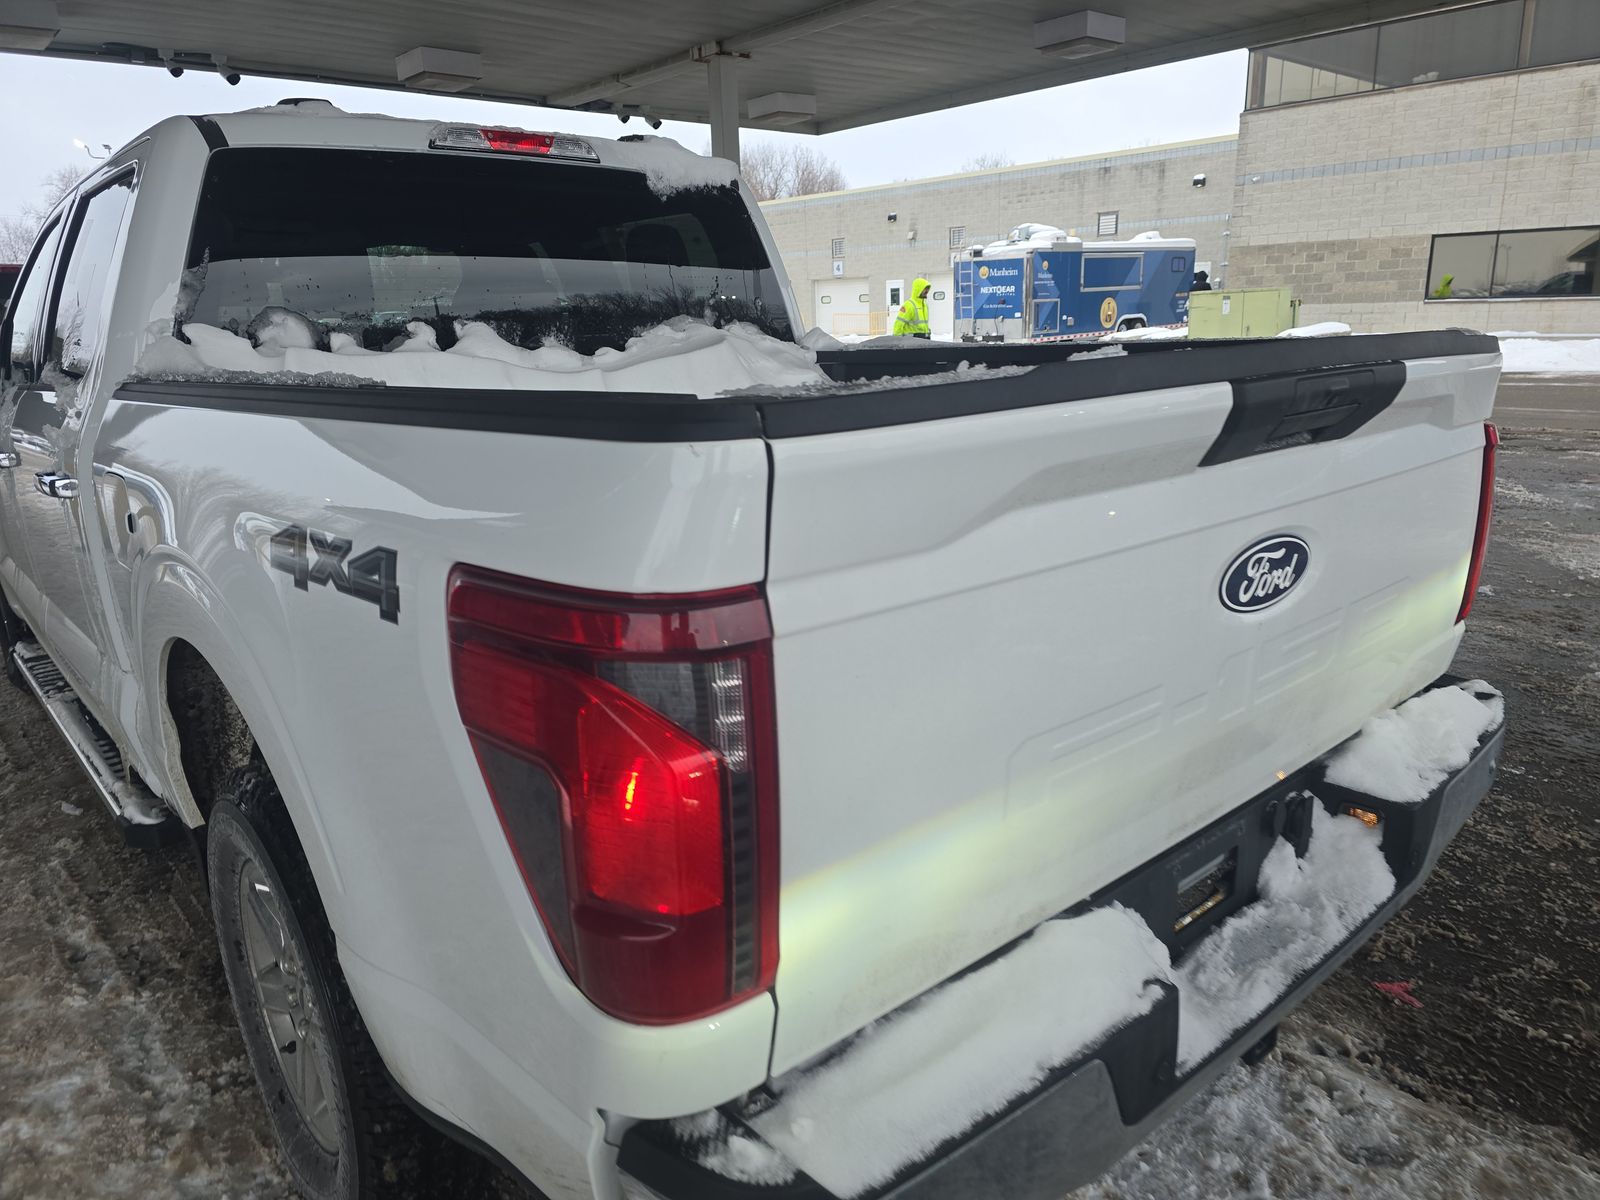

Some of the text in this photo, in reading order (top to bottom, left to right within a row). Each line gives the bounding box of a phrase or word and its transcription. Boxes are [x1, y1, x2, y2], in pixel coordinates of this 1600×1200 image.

[835, 264, 841, 272] 4
[990, 268, 1018, 276] Manheim
[1239, 547, 1299, 603] Ford
